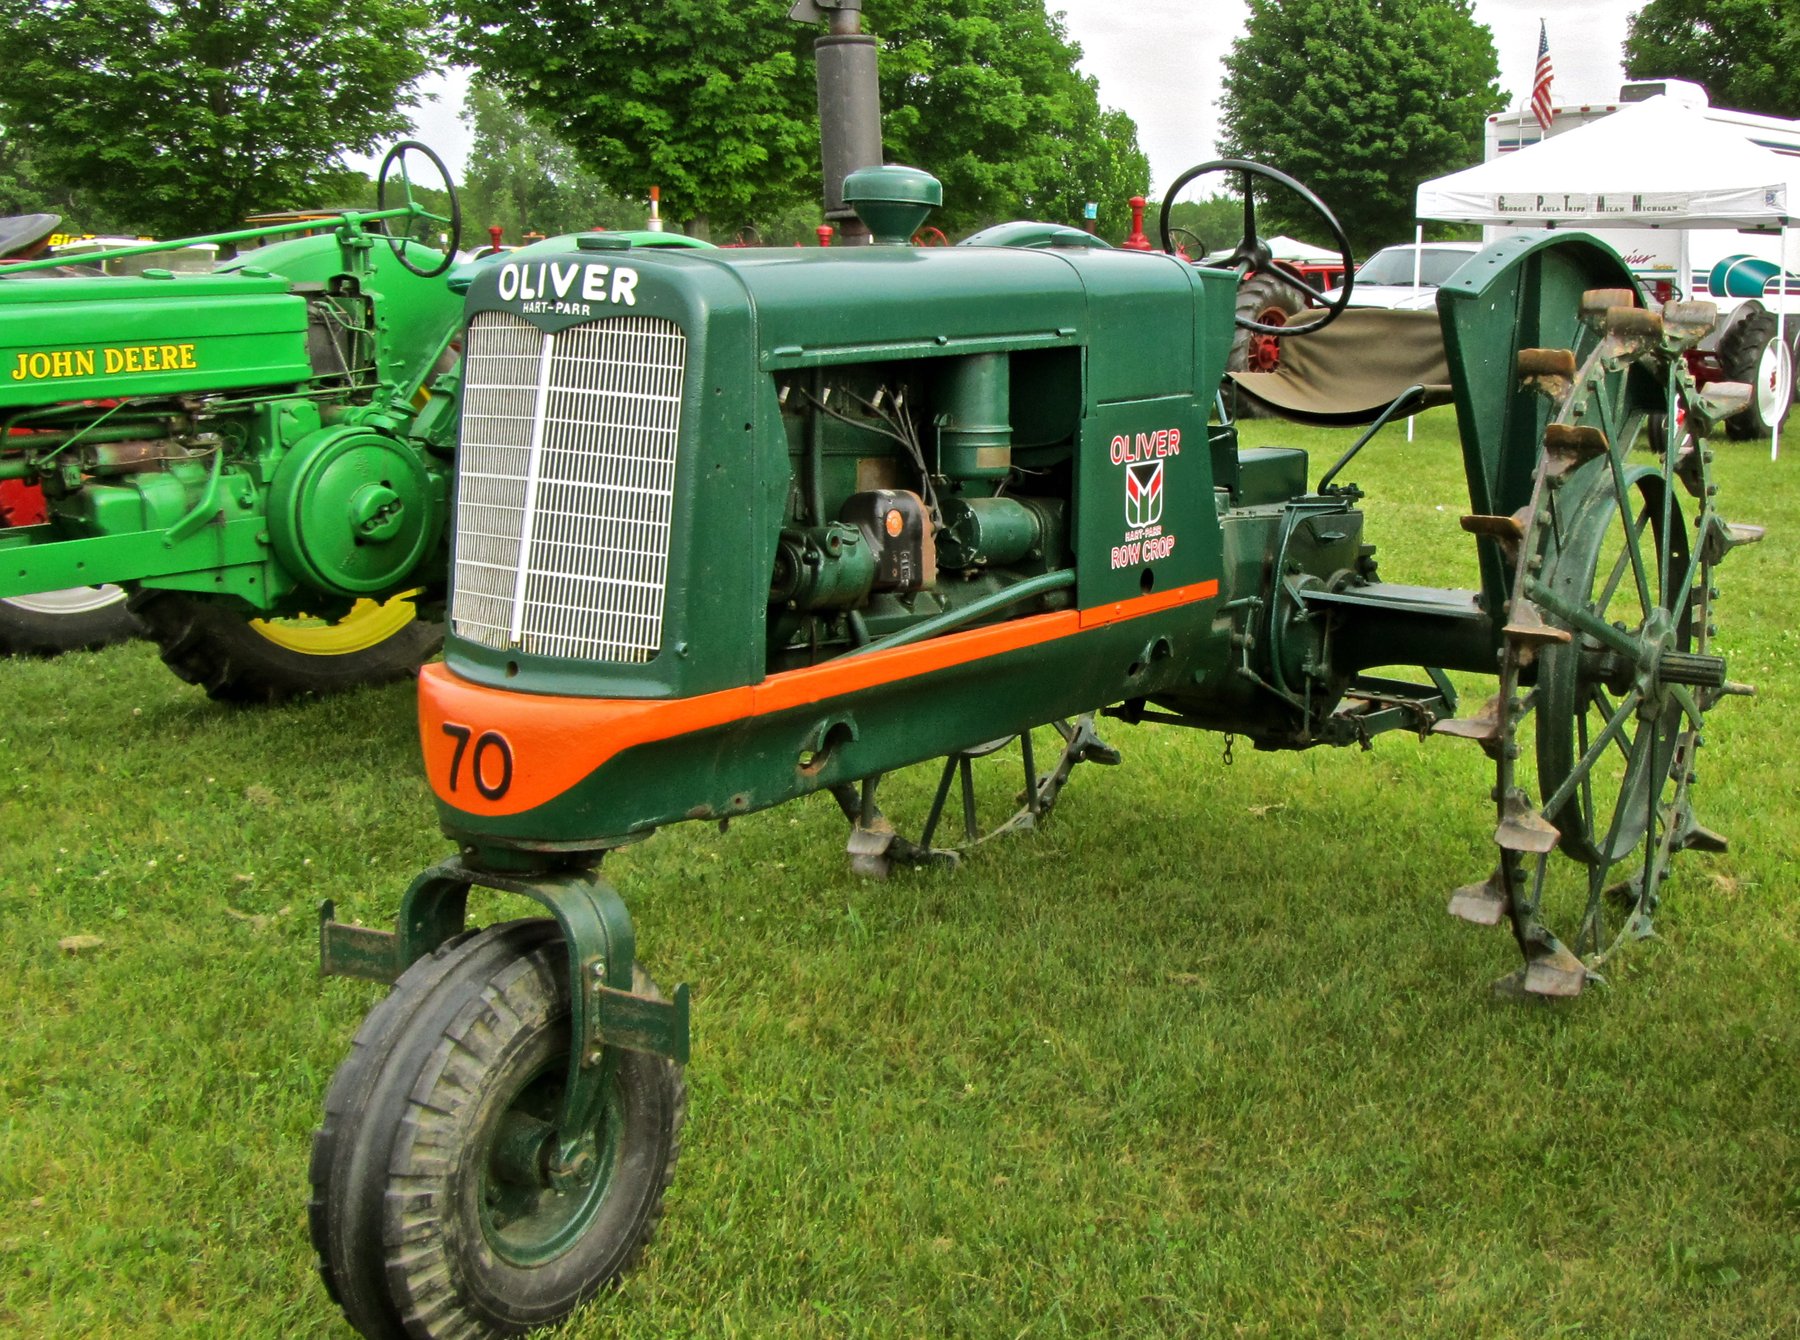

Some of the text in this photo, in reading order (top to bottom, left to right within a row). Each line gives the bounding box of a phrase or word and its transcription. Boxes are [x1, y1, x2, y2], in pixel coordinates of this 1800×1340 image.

[498, 262, 639, 306] OLIVER
[522, 301, 591, 316] HART-PARR
[12, 344, 197, 380] JOHN DEERE
[1110, 428, 1181, 466] OLIVER
[1124, 525, 1162, 542] HART-PARR
[1111, 535, 1175, 570] ROW CROP
[442, 721, 513, 801] 70
